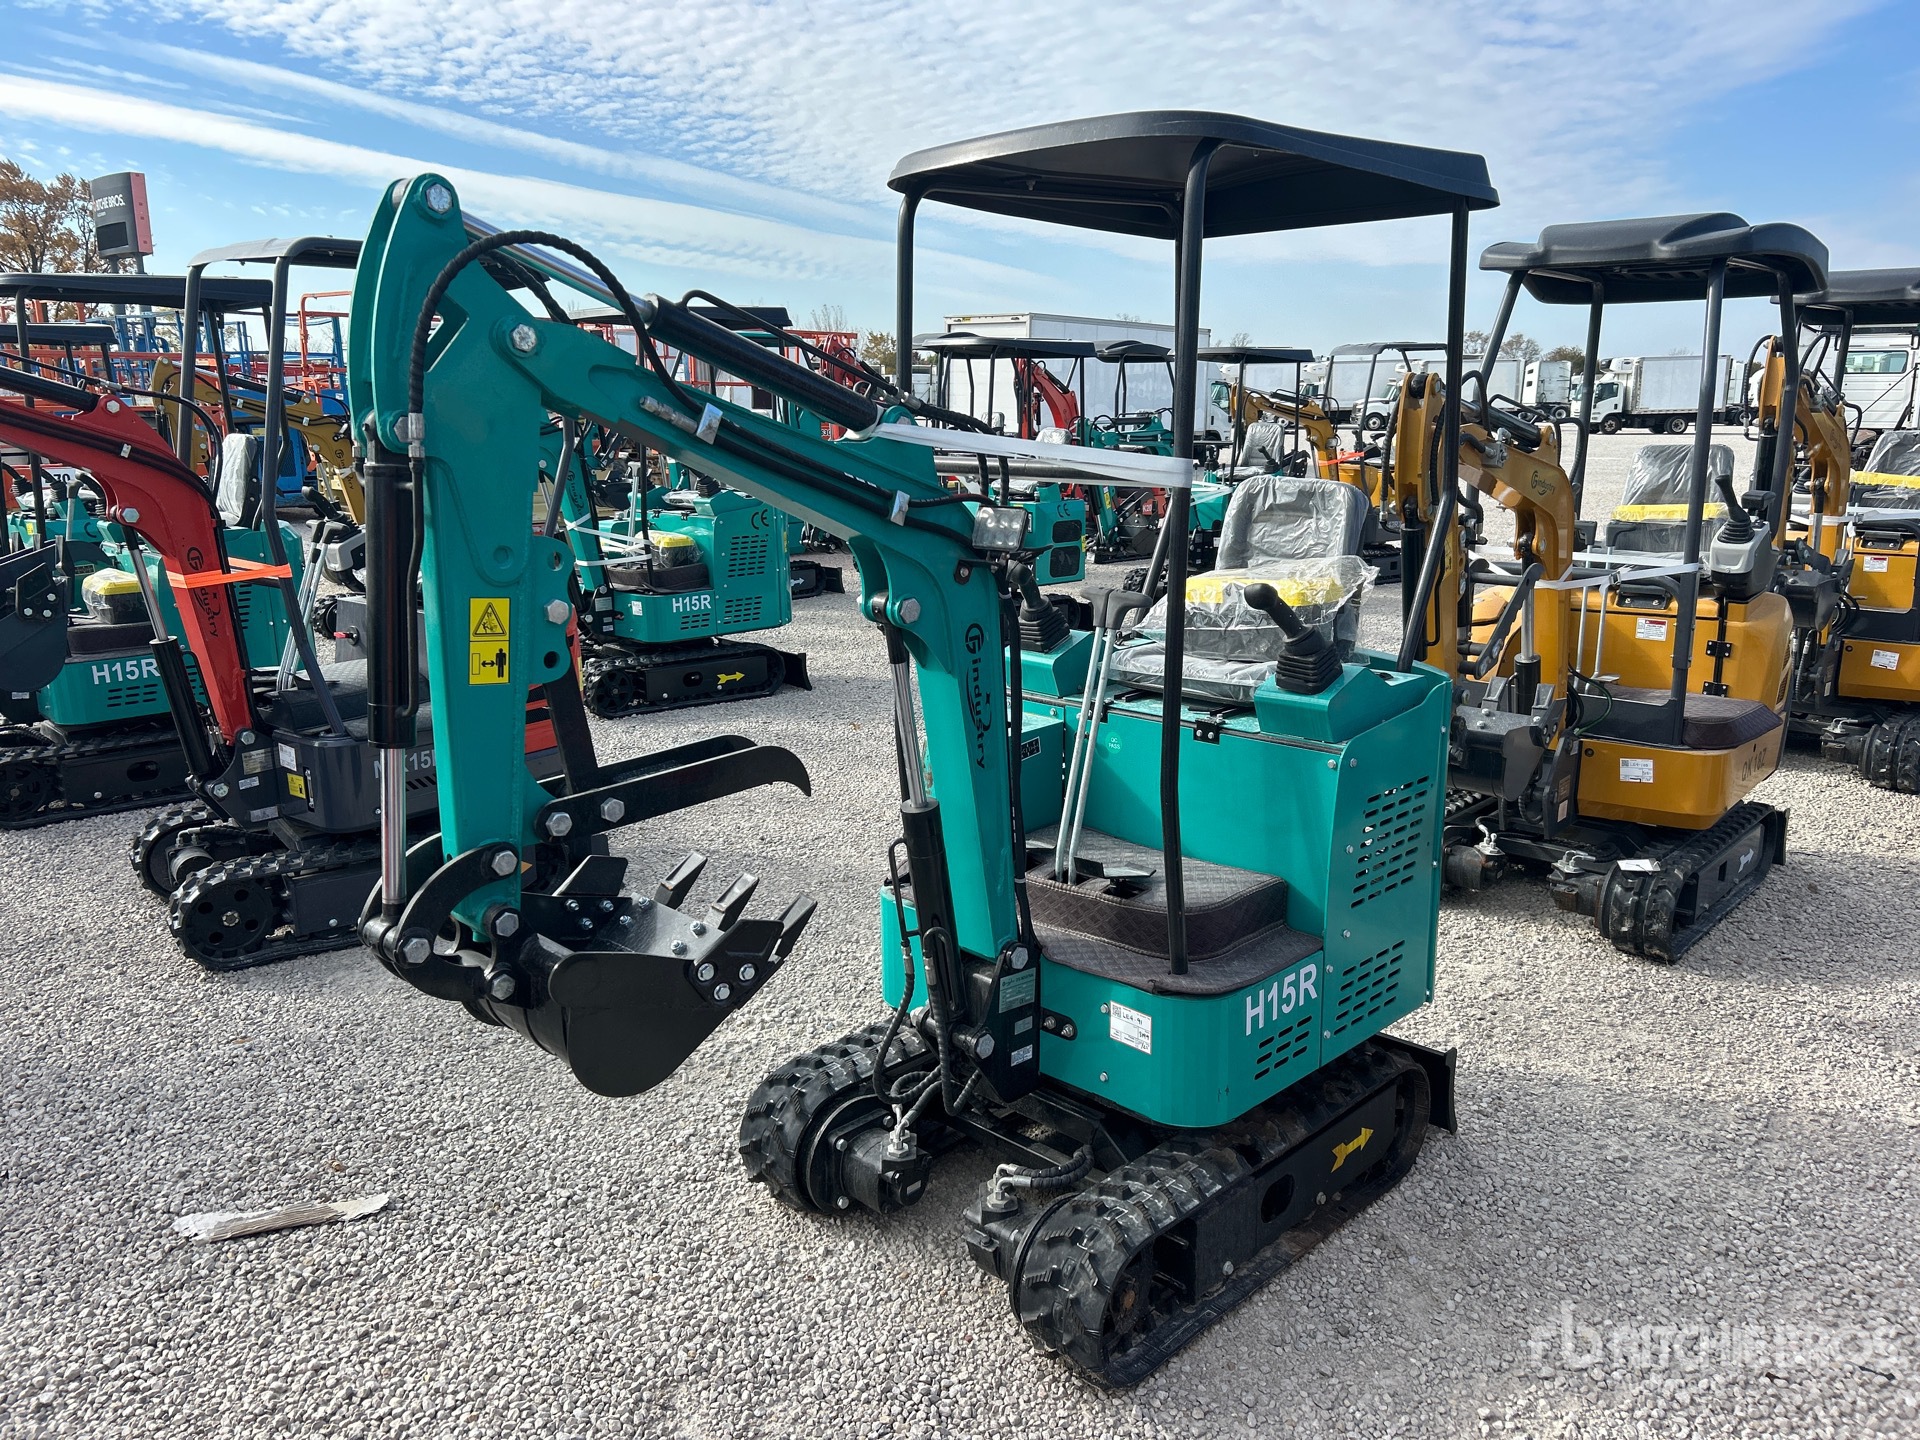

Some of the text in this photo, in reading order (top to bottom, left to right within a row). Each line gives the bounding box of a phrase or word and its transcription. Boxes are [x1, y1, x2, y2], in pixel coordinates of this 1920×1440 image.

[750, 508, 769, 530] CE
[672, 594, 712, 613] H15R
[91, 658, 161, 685] H15R
[1245, 963, 1318, 1037] H15R
